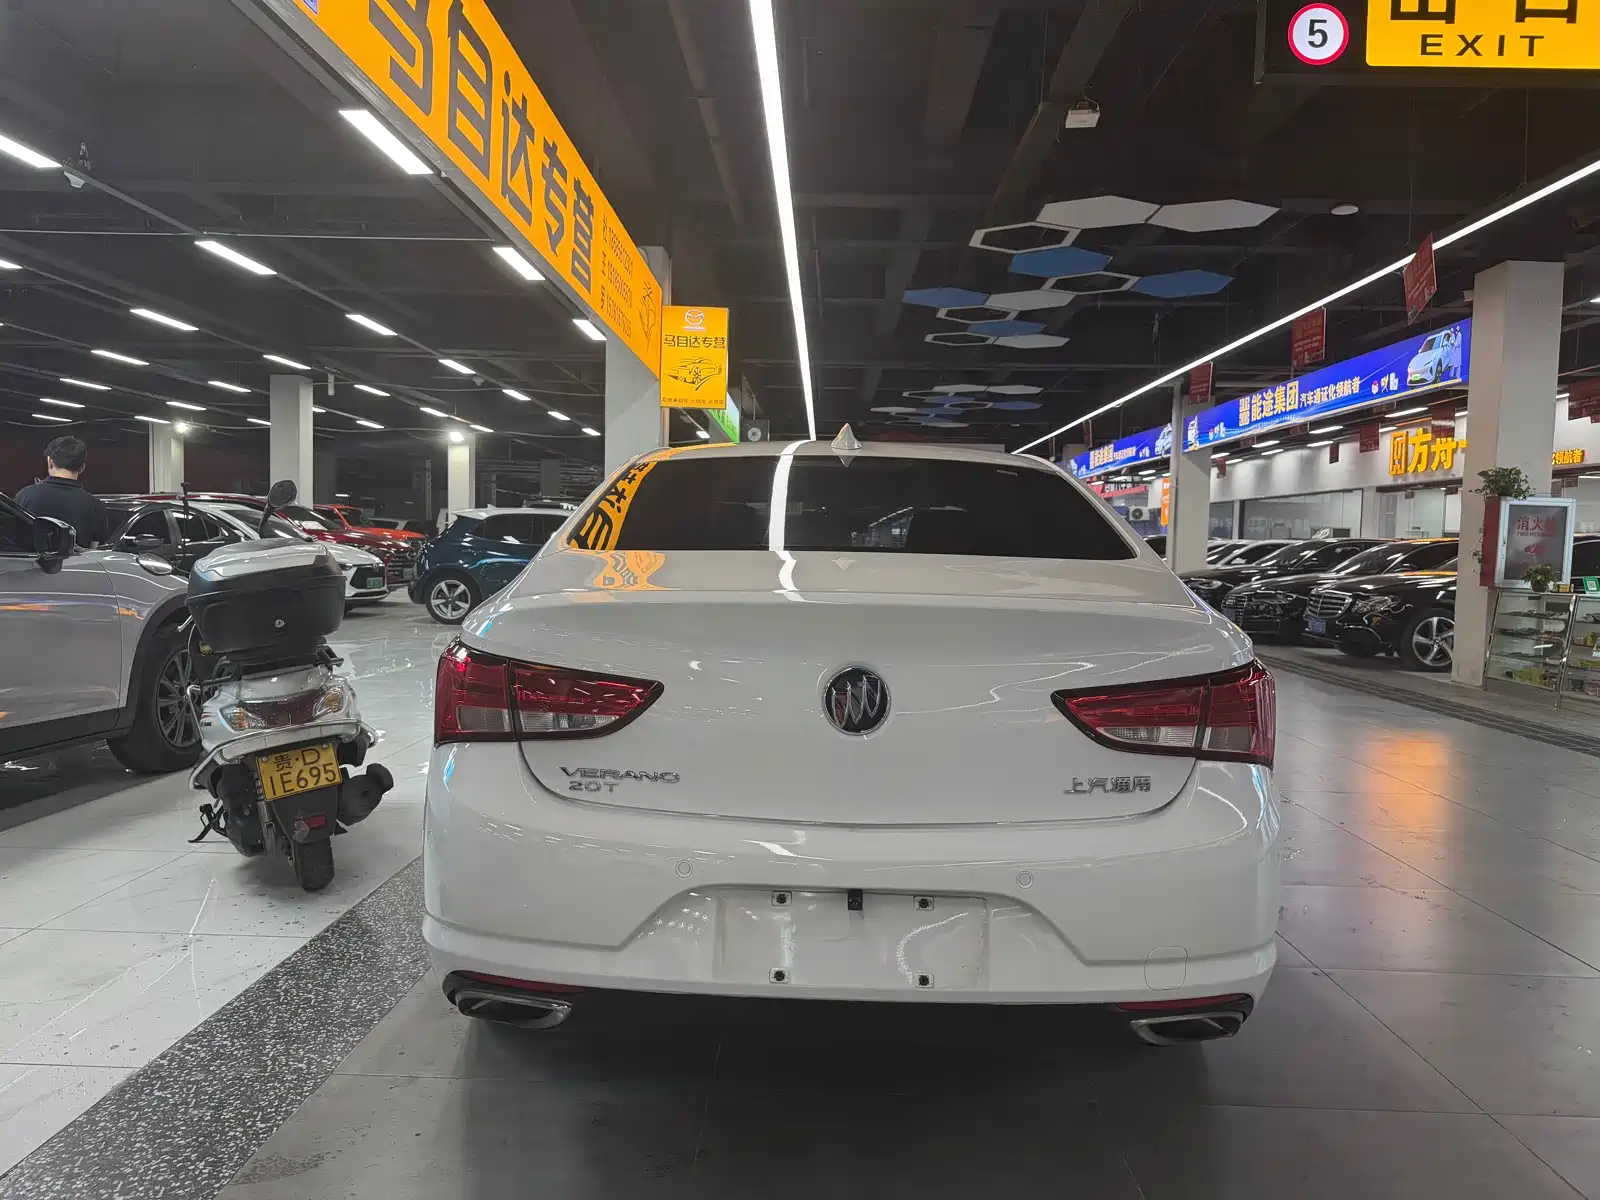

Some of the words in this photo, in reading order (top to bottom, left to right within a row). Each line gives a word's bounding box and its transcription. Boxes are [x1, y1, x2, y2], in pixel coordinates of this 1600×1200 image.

[1307, 18, 1329, 49] 5
[1420, 34, 1545, 57] EXIT
[664, 334, 726, 349] 马自达专营
[1251, 380, 1299, 422] 能途集团
[1408, 427, 1468, 473] 方舟
[559, 766, 681, 784] VERANO
[1062, 775, 1152, 795] 上汽通用
